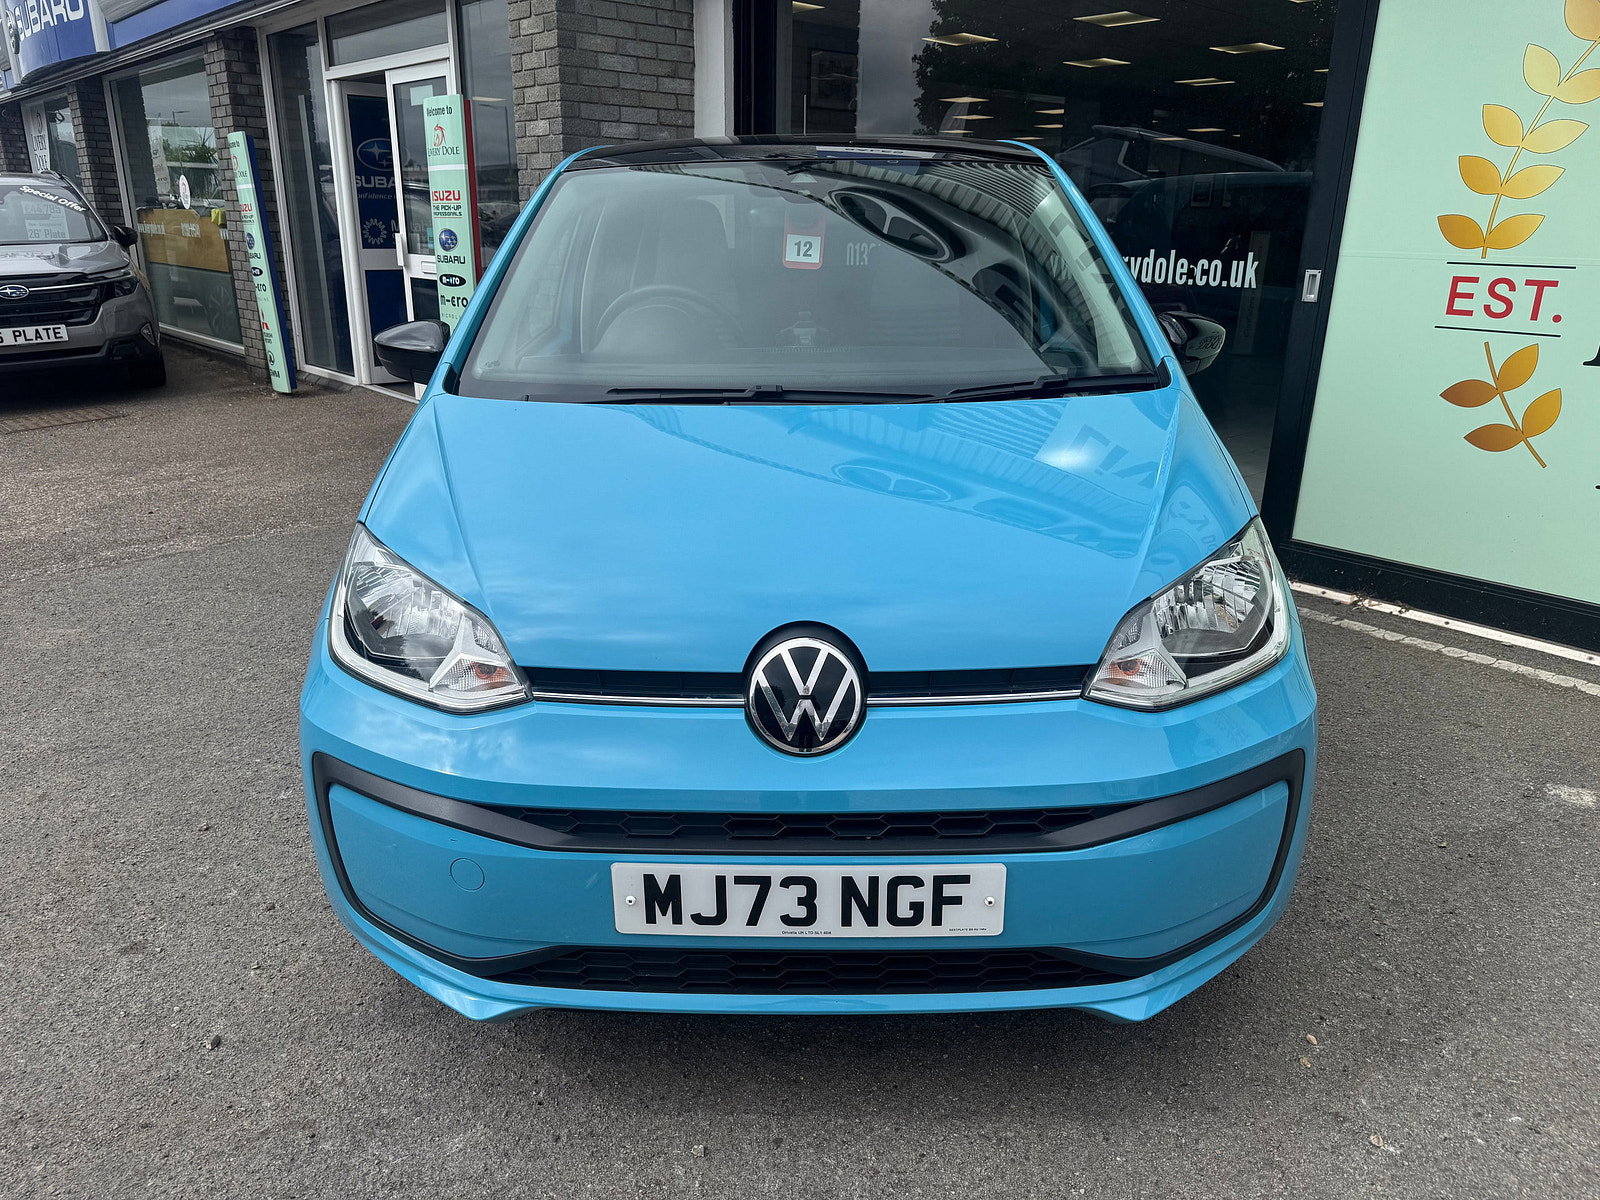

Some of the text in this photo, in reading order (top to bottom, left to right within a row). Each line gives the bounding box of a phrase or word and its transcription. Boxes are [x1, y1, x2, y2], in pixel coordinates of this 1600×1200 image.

[446, 105, 453, 115] to
[442, 145, 460, 156] DOLE
[20, 186, 86, 212] Special Offer
[432, 190, 461, 201] ISUZU
[794, 240, 812, 258] 12
[437, 254, 466, 264] SUBARU
[1445, 275, 1562, 324] EST.
[11, 326, 64, 343] PLATE
[642, 873, 971, 928] MJ73 NGF
